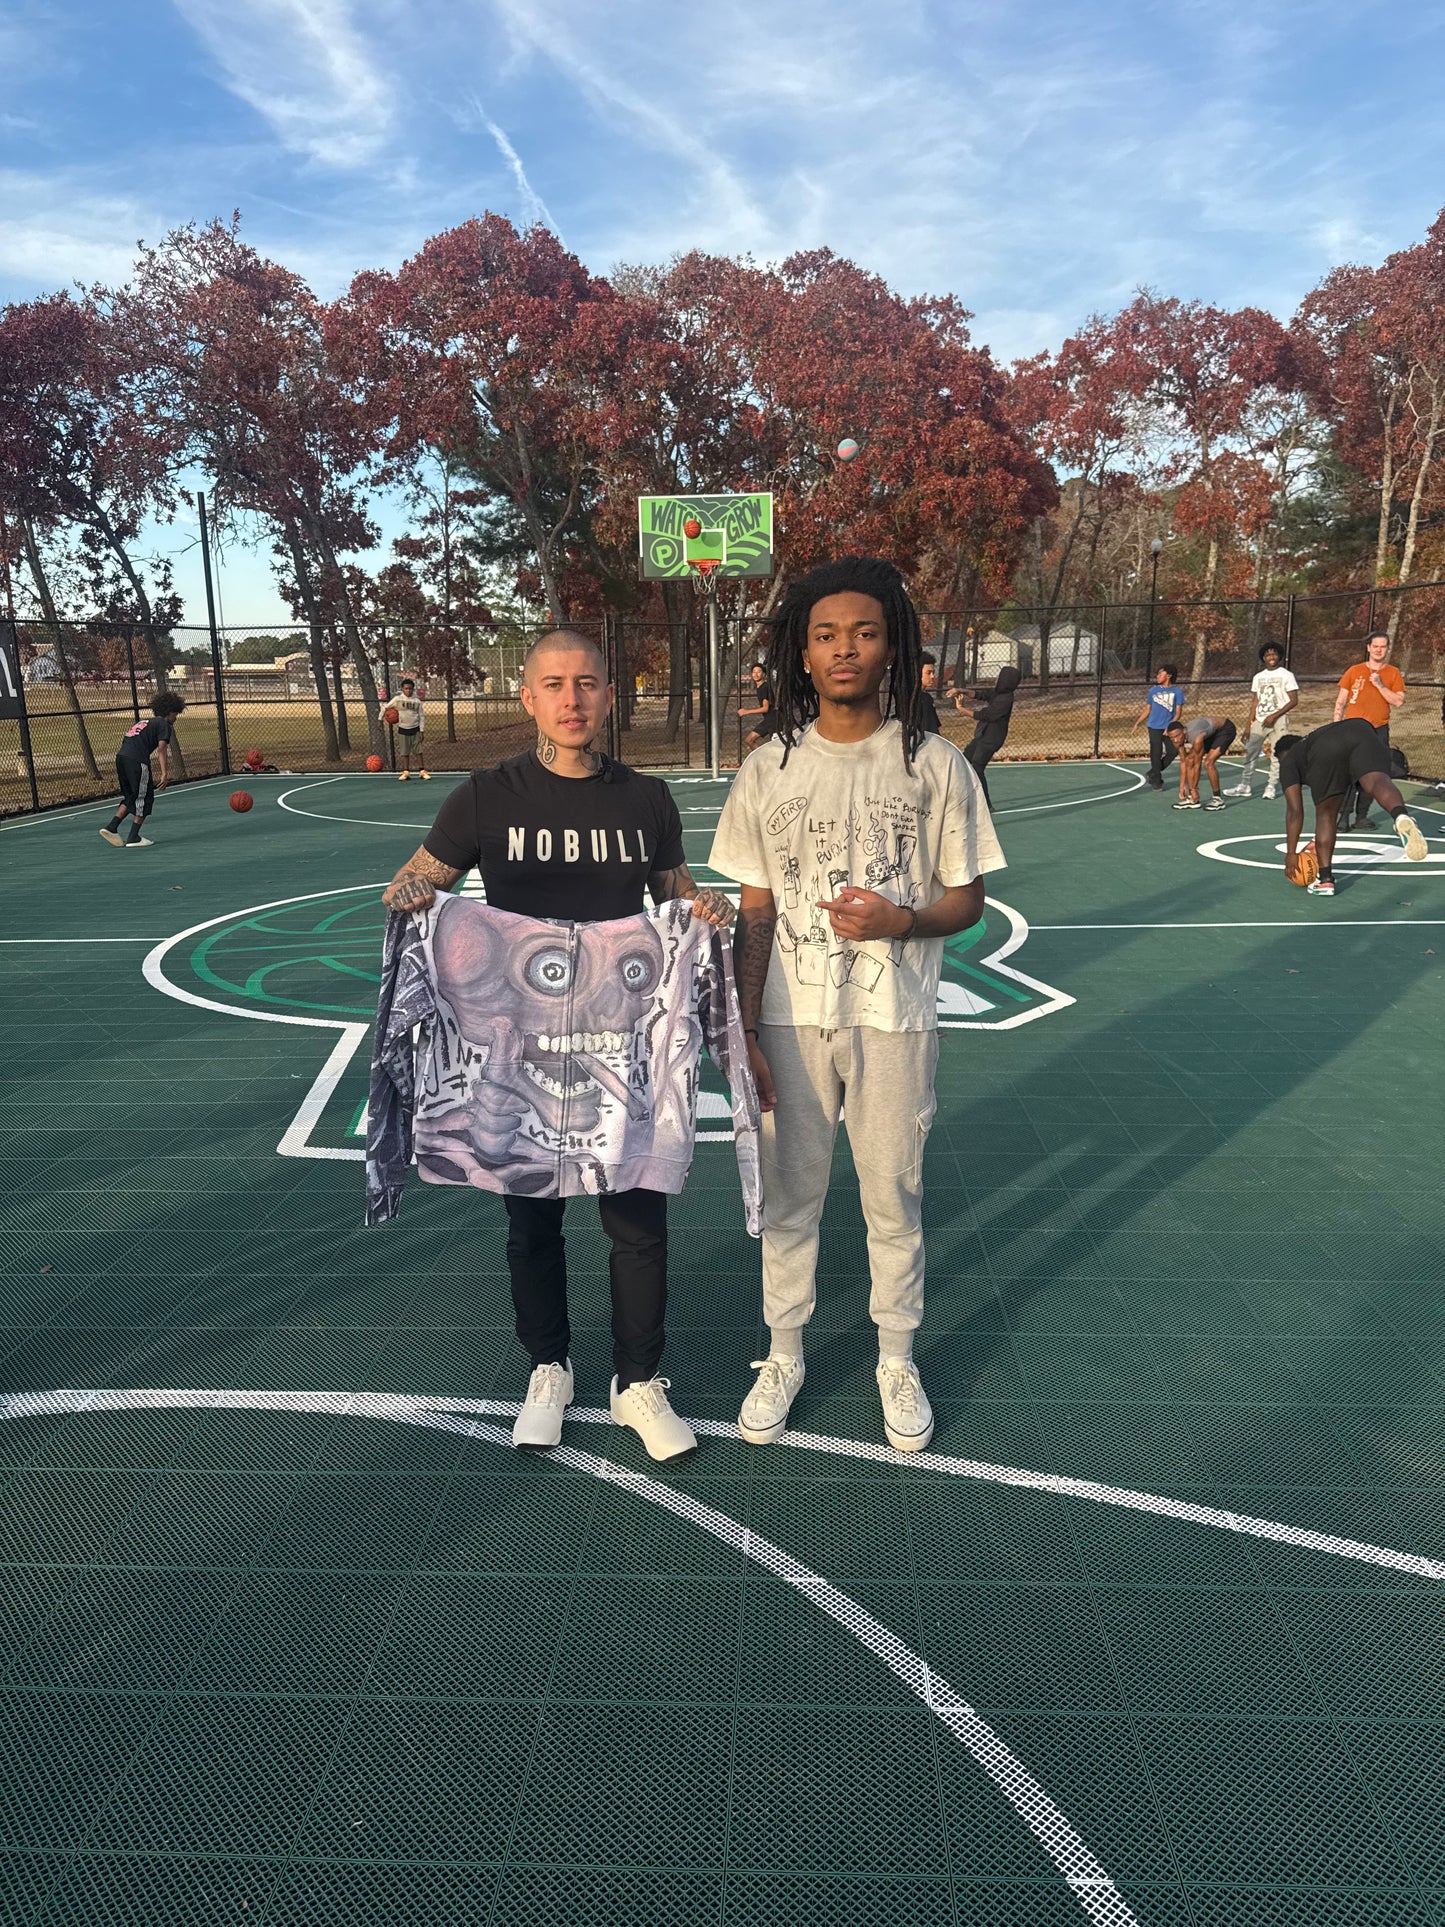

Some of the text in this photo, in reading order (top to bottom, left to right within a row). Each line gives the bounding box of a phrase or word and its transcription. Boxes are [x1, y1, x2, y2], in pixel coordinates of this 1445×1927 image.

[726, 499, 762, 543] GROW
[780, 799, 803, 821] FIRE
[808, 818, 837, 834] LET
[507, 826, 650, 863] NOBULL
